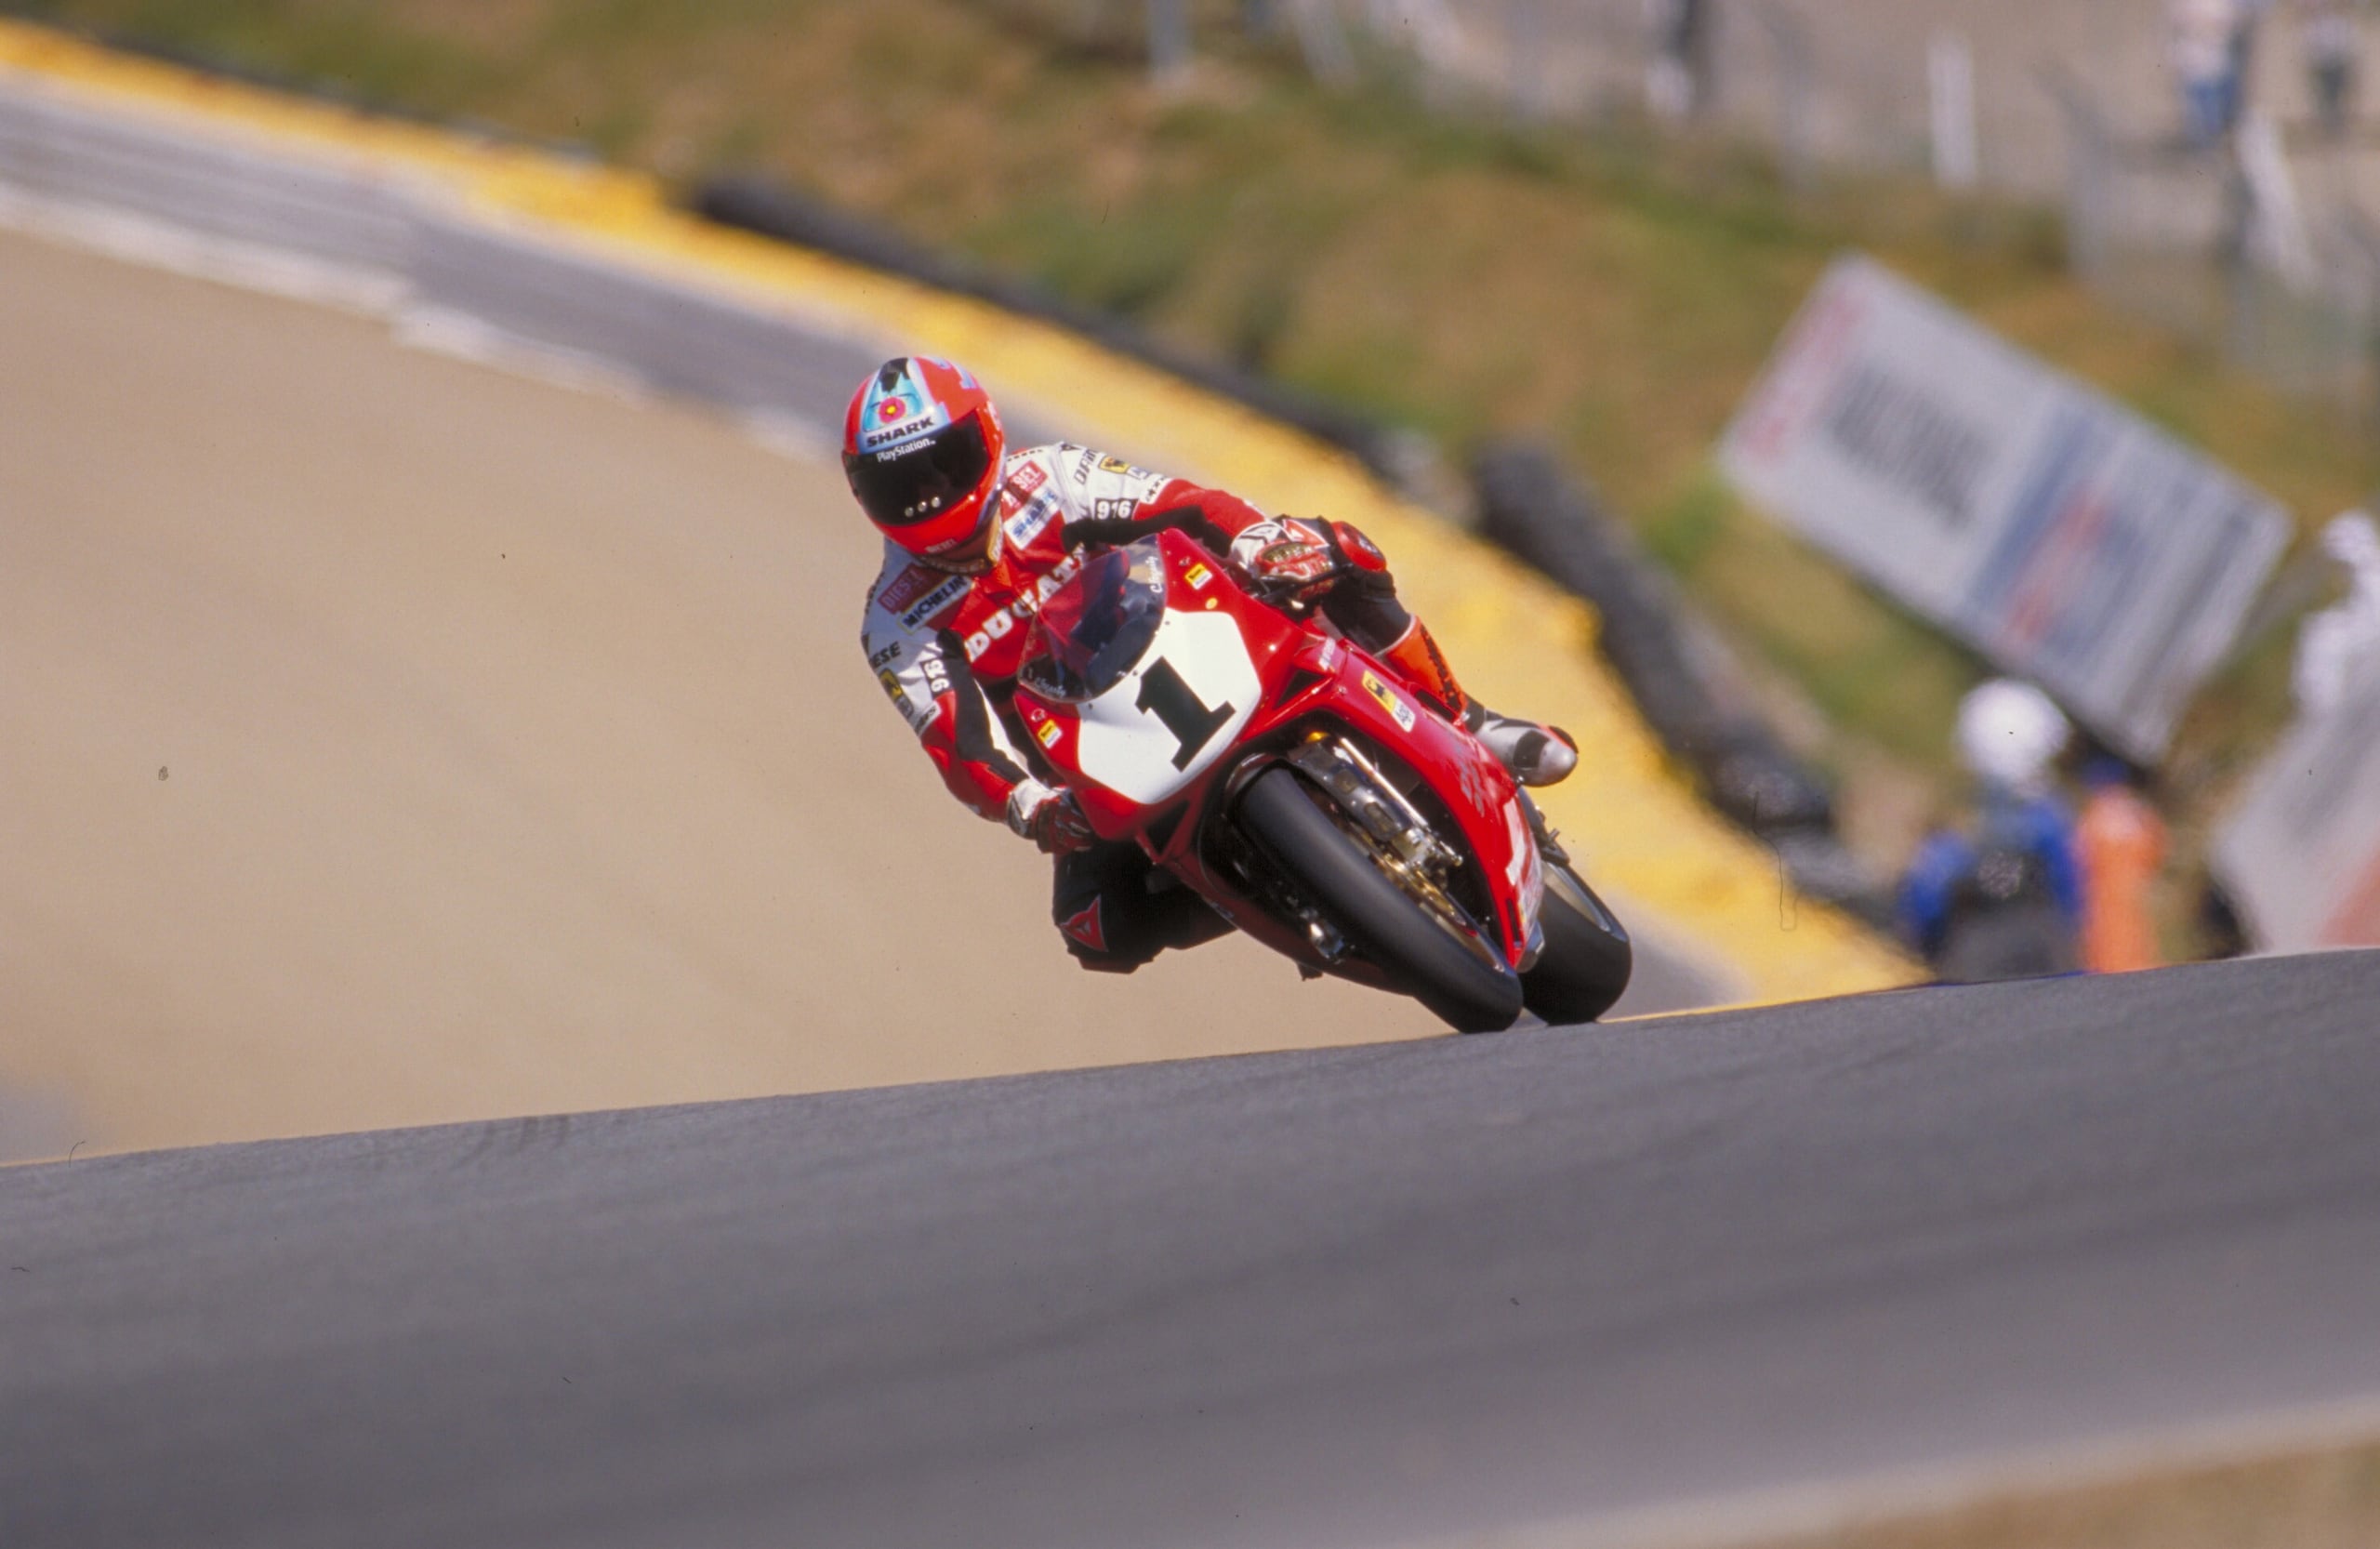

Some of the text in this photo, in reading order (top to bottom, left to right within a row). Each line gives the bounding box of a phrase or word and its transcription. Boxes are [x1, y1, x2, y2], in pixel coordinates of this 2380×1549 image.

[866, 417, 934, 447] SHARK
[877, 439, 931, 463] PlayStation
[1096, 499, 1131, 521] 916
[902, 576, 967, 628] MICHELIN
[1135, 655, 1236, 773] 1
